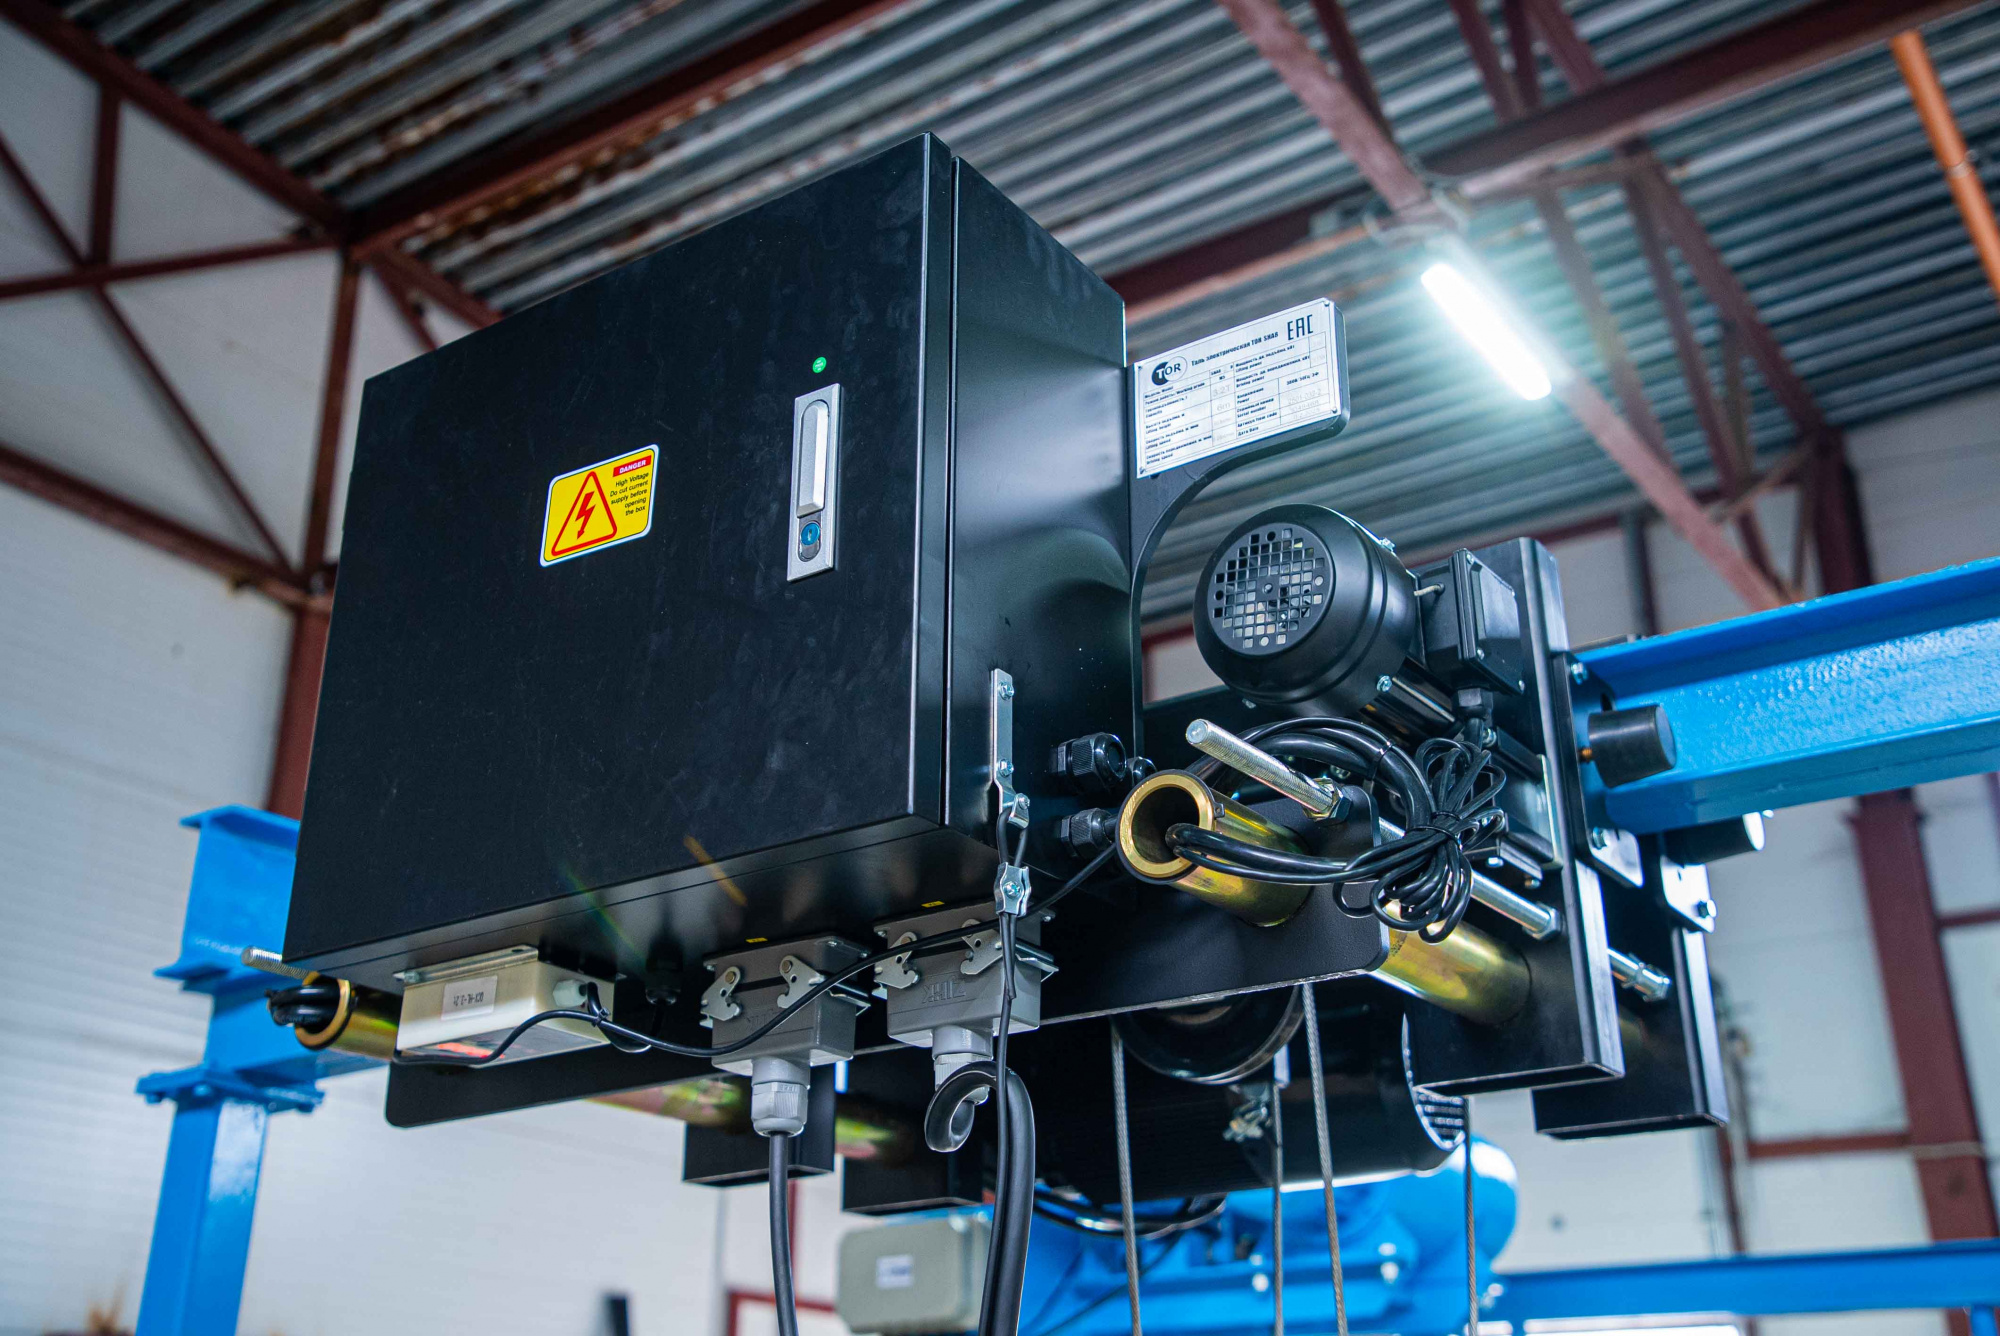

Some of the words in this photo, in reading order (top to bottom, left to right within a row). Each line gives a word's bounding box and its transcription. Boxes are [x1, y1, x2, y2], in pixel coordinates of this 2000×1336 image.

[1286, 315, 1314, 340] EAC
[1192, 357, 1204, 366] Таль
[1207, 342, 1250, 360] электрическая
[1156, 363, 1180, 378] TOR
[619, 460, 646, 474] DANGER
[616, 478, 628, 487] High
[630, 472, 649, 482] Voltage
[629, 480, 648, 490] current
[611, 495, 628, 504] supply
[630, 489, 647, 498] before
[624, 498, 646, 508] opening
